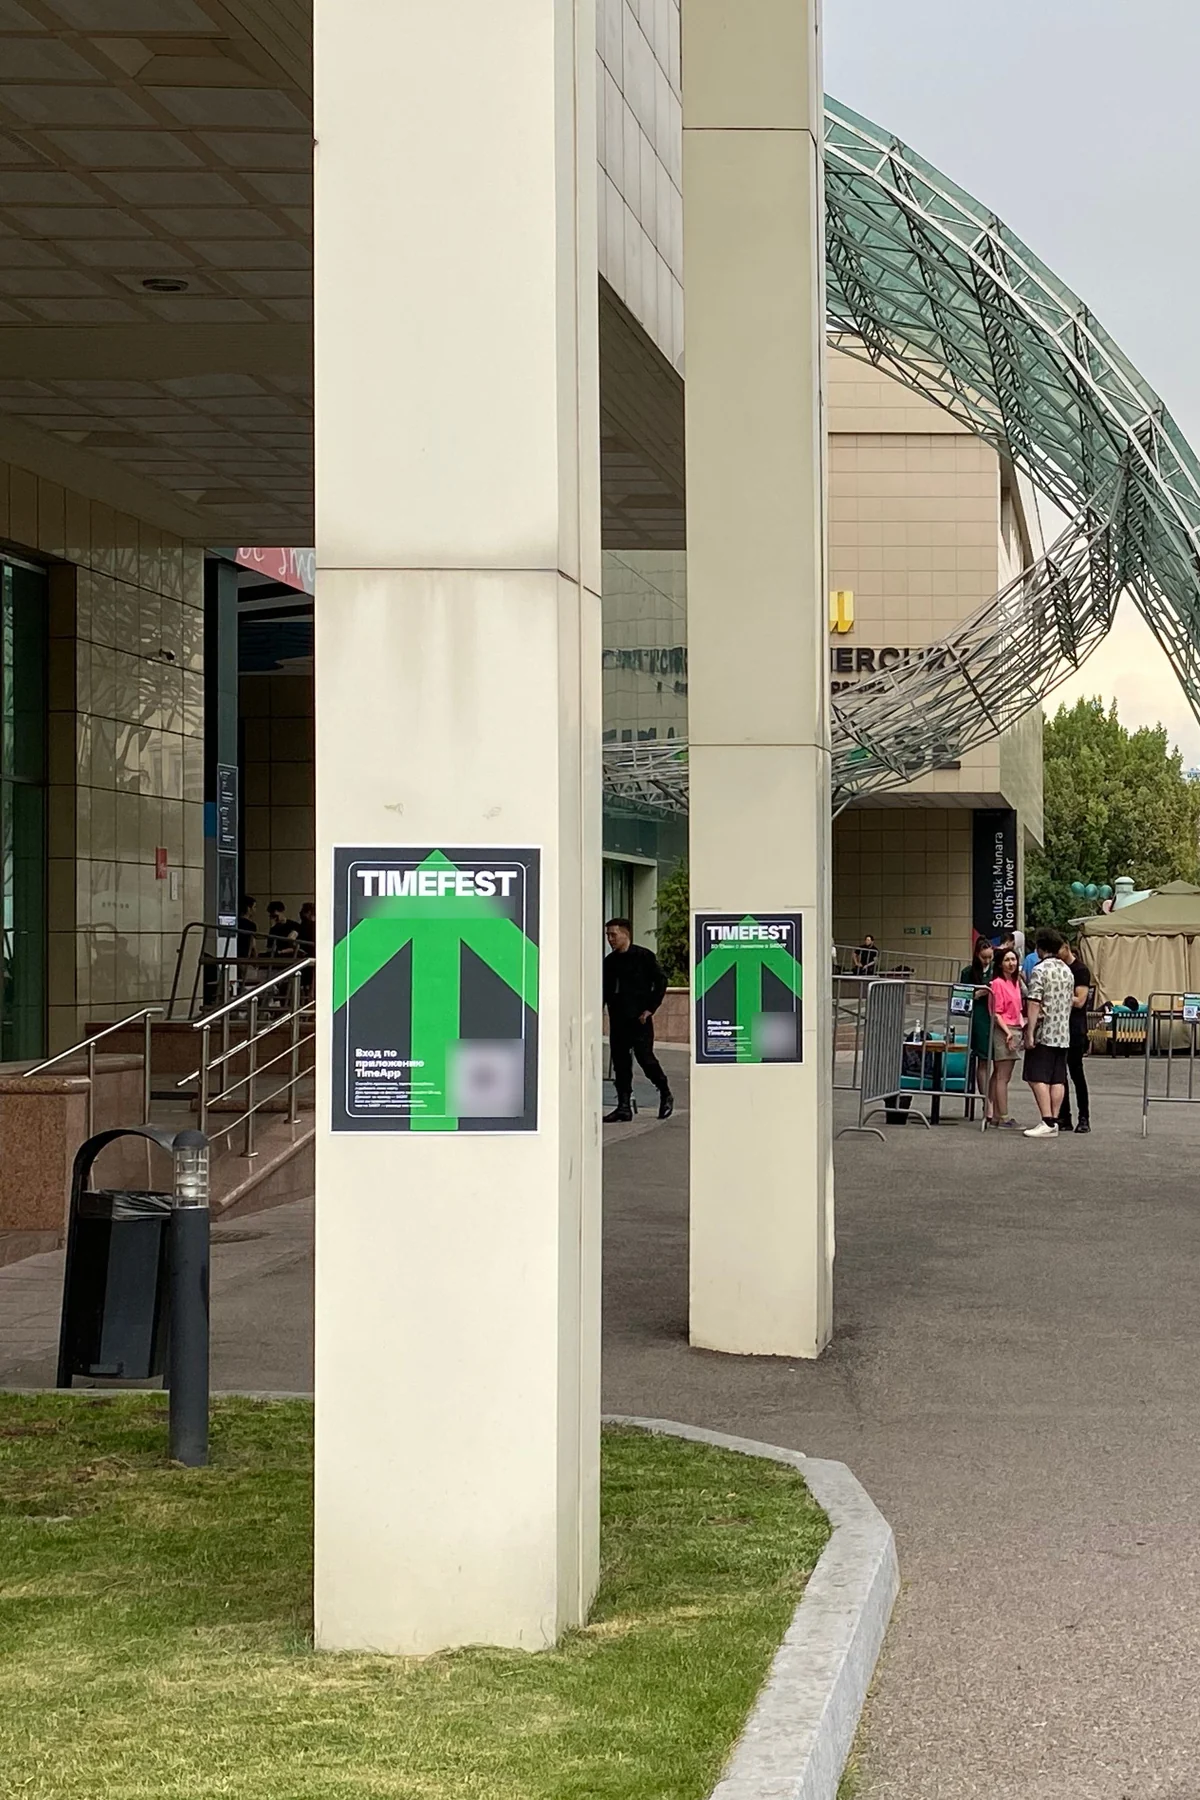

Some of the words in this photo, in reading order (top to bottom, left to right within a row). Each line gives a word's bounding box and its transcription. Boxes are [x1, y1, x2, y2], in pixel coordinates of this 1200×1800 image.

[993, 832, 1003, 875] Munara
[357, 870, 517, 897] TIMEFEST
[1004, 858, 1014, 892] Tower
[1004, 895, 1014, 928] North
[706, 925, 791, 940] TIMEFEST
[355, 1048, 381, 1058] Вход
[354, 1068, 401, 1079] TimeApp
